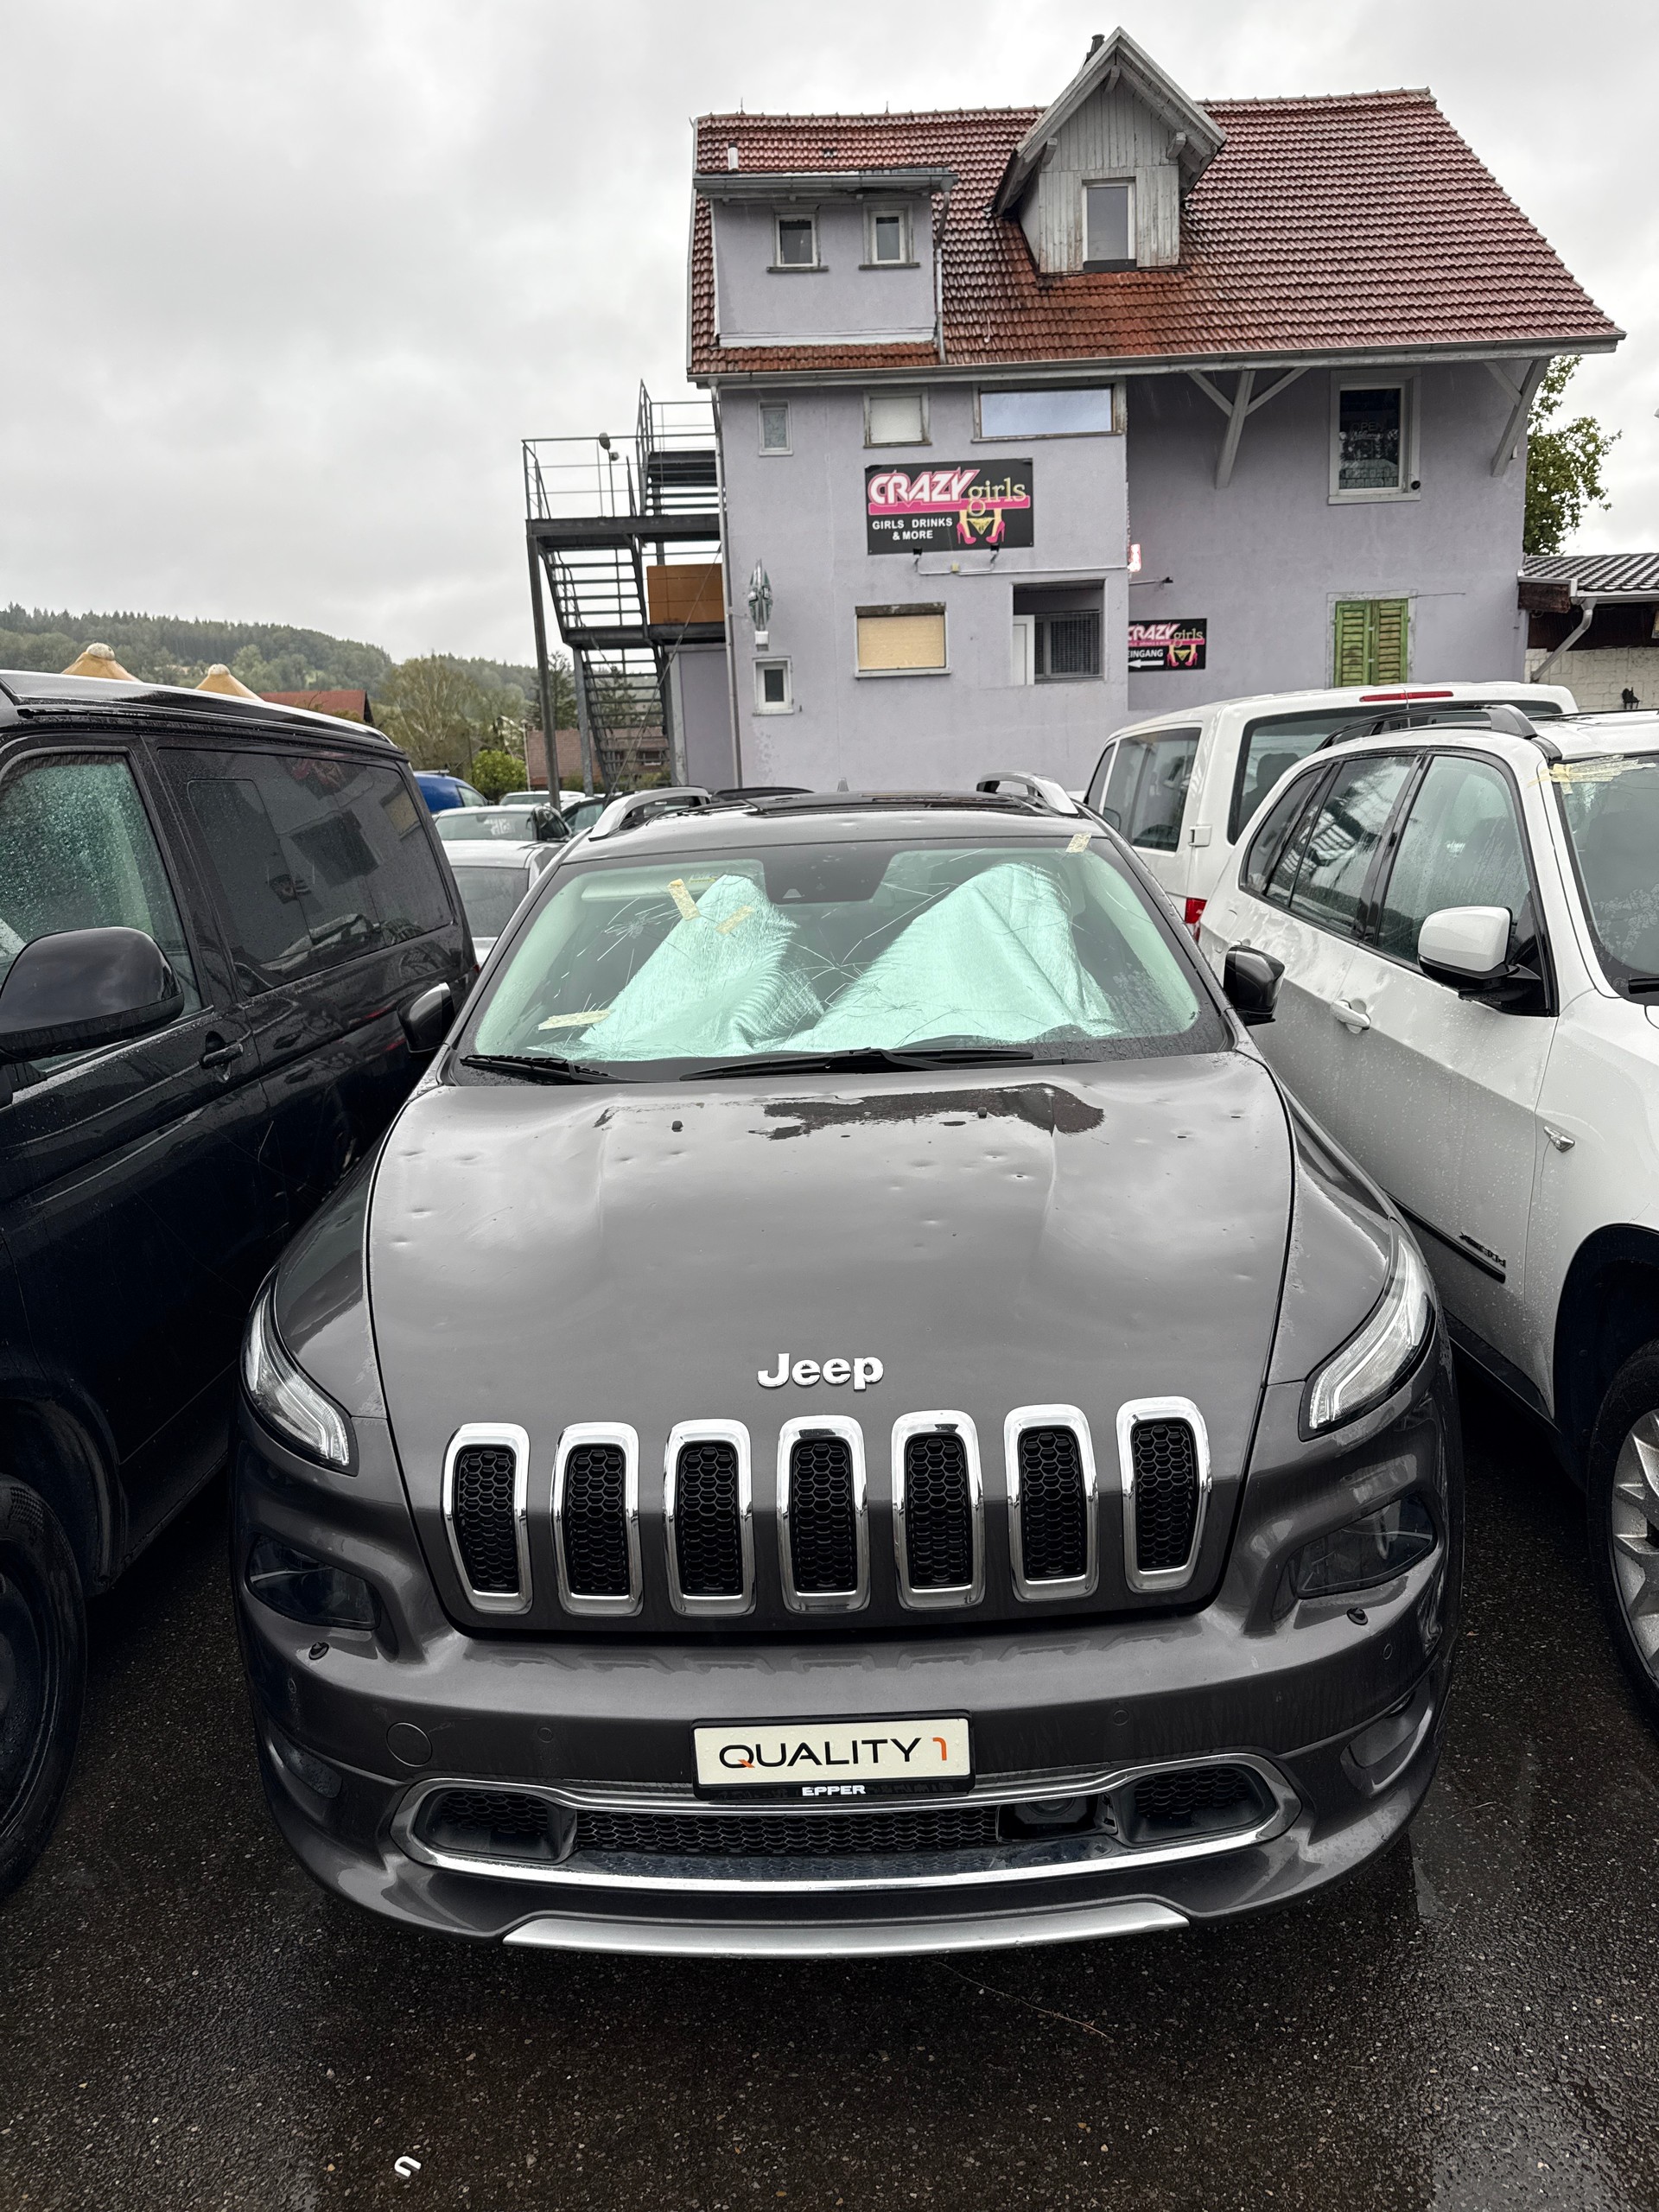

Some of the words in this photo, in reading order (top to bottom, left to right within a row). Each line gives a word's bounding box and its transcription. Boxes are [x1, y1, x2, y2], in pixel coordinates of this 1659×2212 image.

[868, 467, 980, 507] CRAZY
[967, 477, 1027, 517] girls
[872, 519, 905, 530] GIRLS
[912, 518, 953, 528] DRINKS
[892, 531, 900, 541] &
[902, 531, 934, 540] MORE
[1173, 628, 1203, 647] girls
[757, 1352, 884, 1391] Jeep
[719, 1737, 922, 1769] QUALITY
[802, 1784, 866, 1796] EPPER
